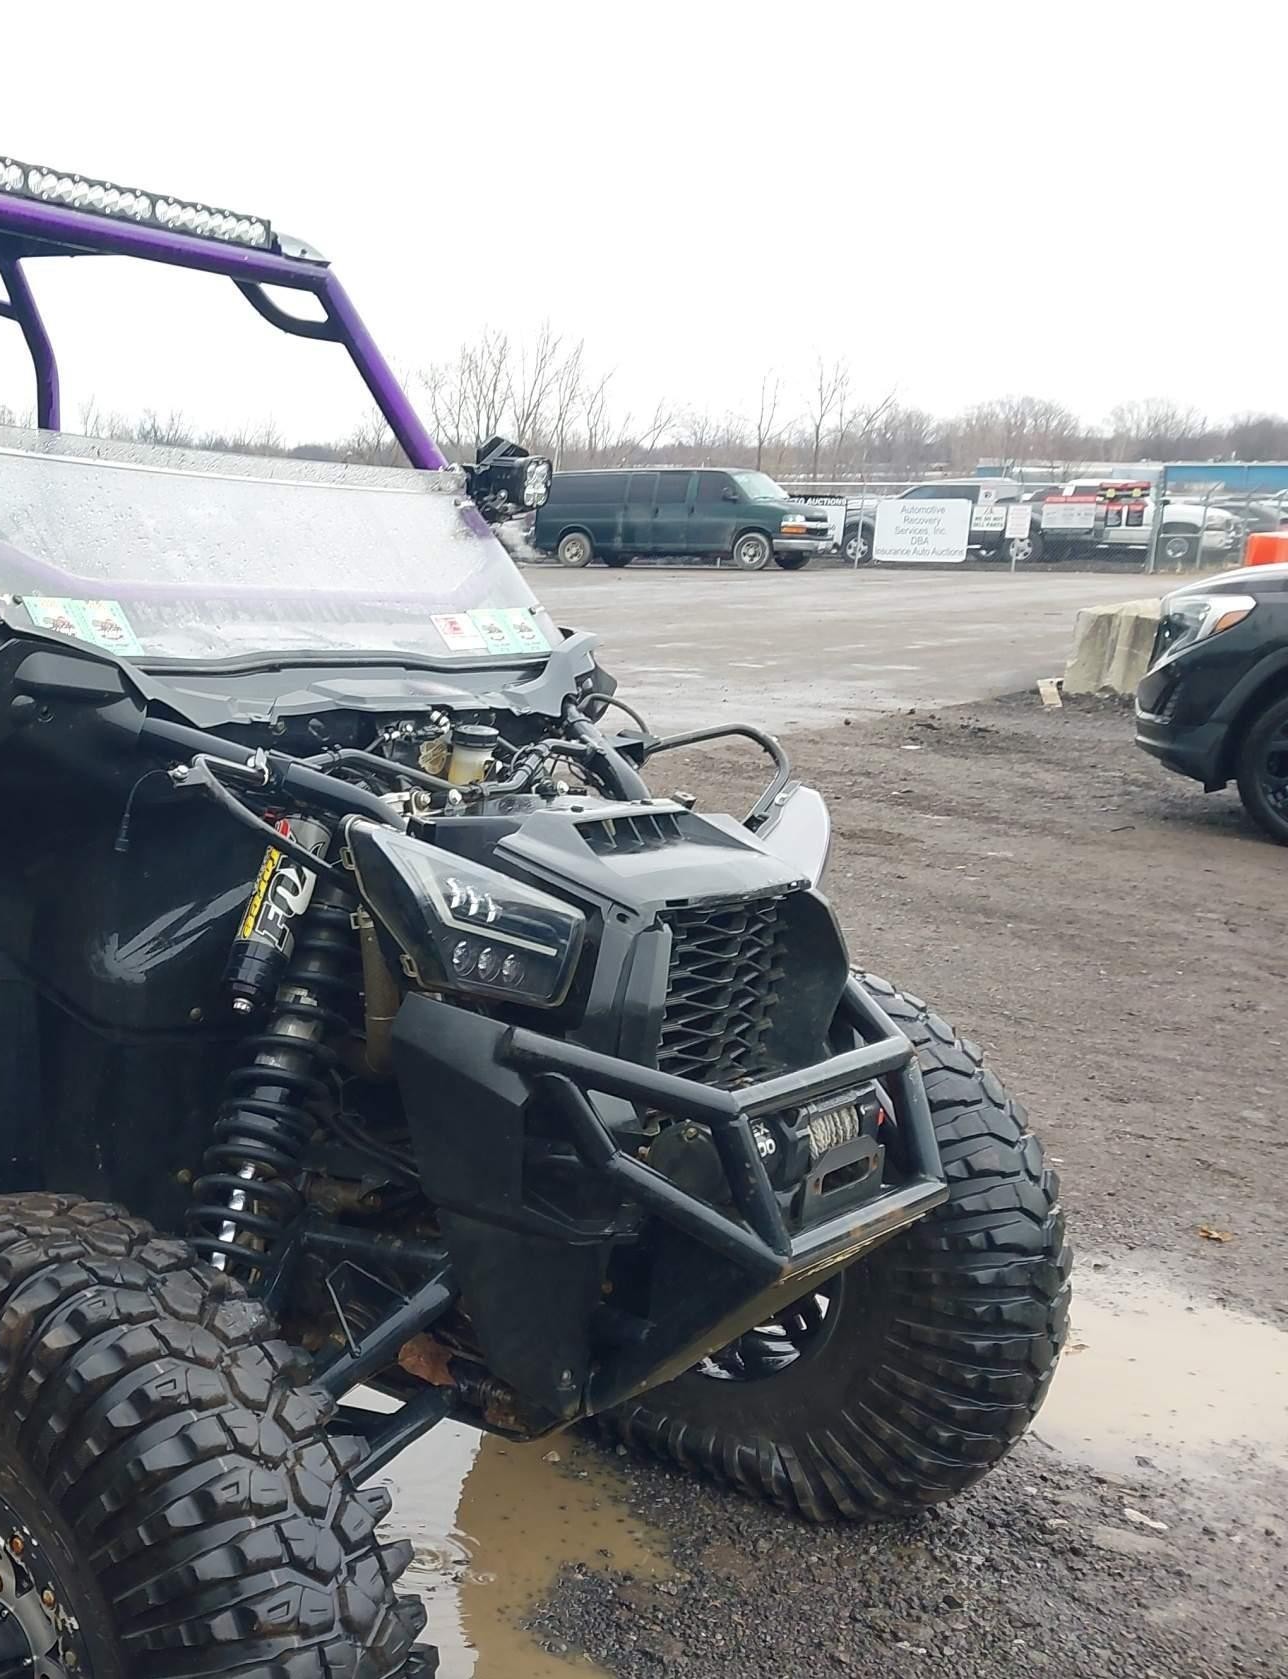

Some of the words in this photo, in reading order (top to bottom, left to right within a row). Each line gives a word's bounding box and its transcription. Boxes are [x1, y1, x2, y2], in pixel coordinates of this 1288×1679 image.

[807, 497, 847, 506] AUCTIONS
[900, 505, 947, 514] Automotive
[903, 515, 942, 527] Recovery
[910, 535, 930, 546] DBA
[874, 545, 911, 556] Insurance
[911, 545, 930, 556] Auto
[930, 546, 965, 557] Auctions
